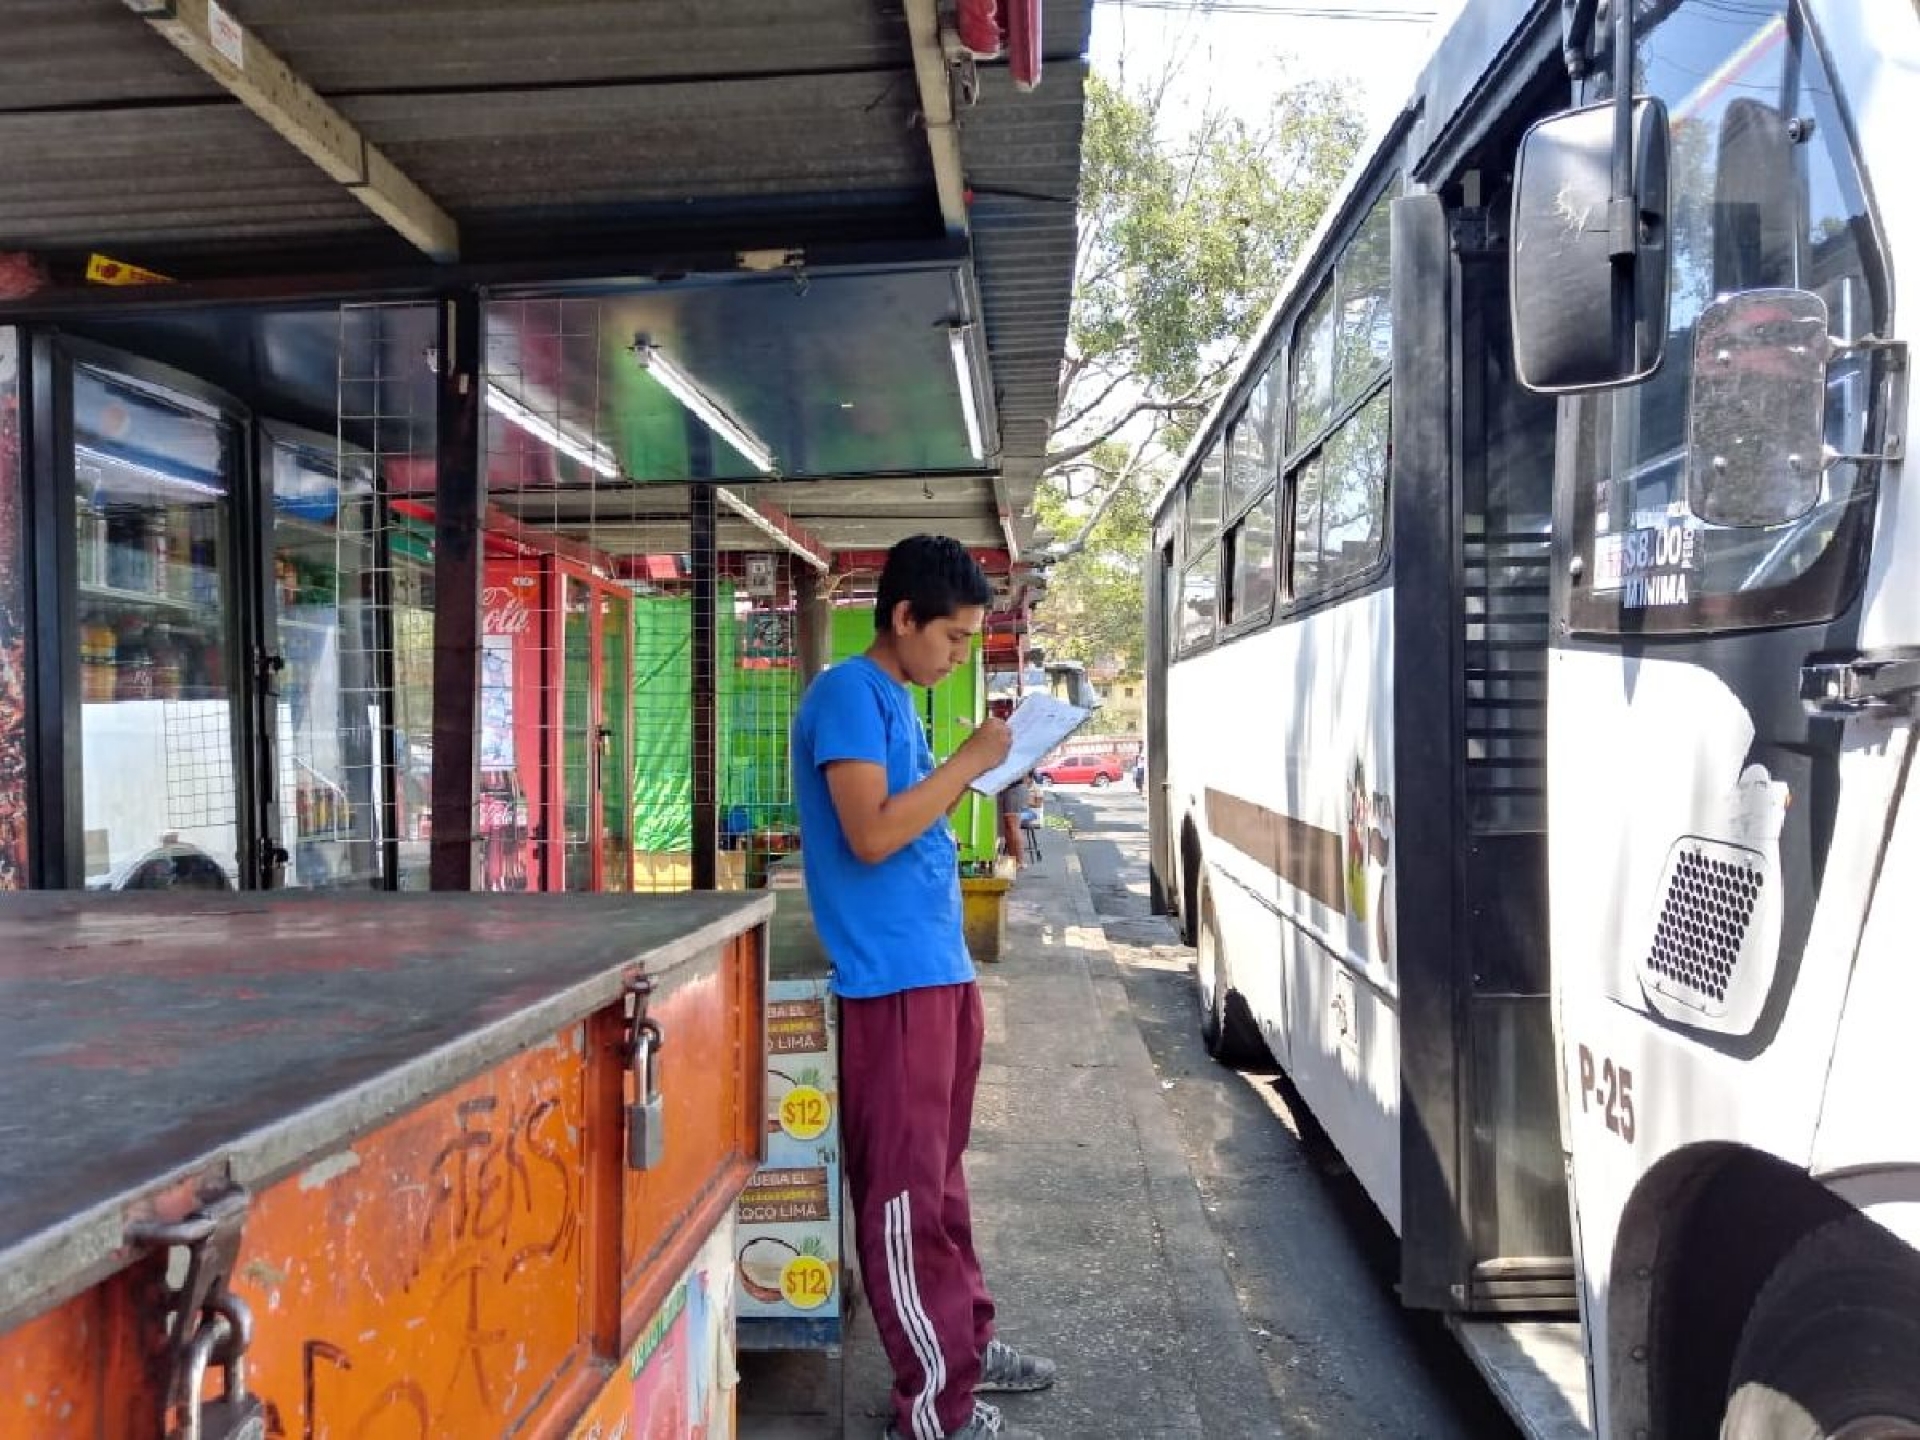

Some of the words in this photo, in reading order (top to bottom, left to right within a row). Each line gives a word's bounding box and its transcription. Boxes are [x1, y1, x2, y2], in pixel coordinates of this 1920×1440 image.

[778, 1033, 817, 1049] LIMA
[1579, 1043, 1636, 1145] P-25
[783, 1099, 824, 1126] $12
[792, 1171, 808, 1185] EL
[739, 1206, 777, 1220] OCO
[780, 1202, 817, 1217] LIMA
[786, 1268, 827, 1295] $12
